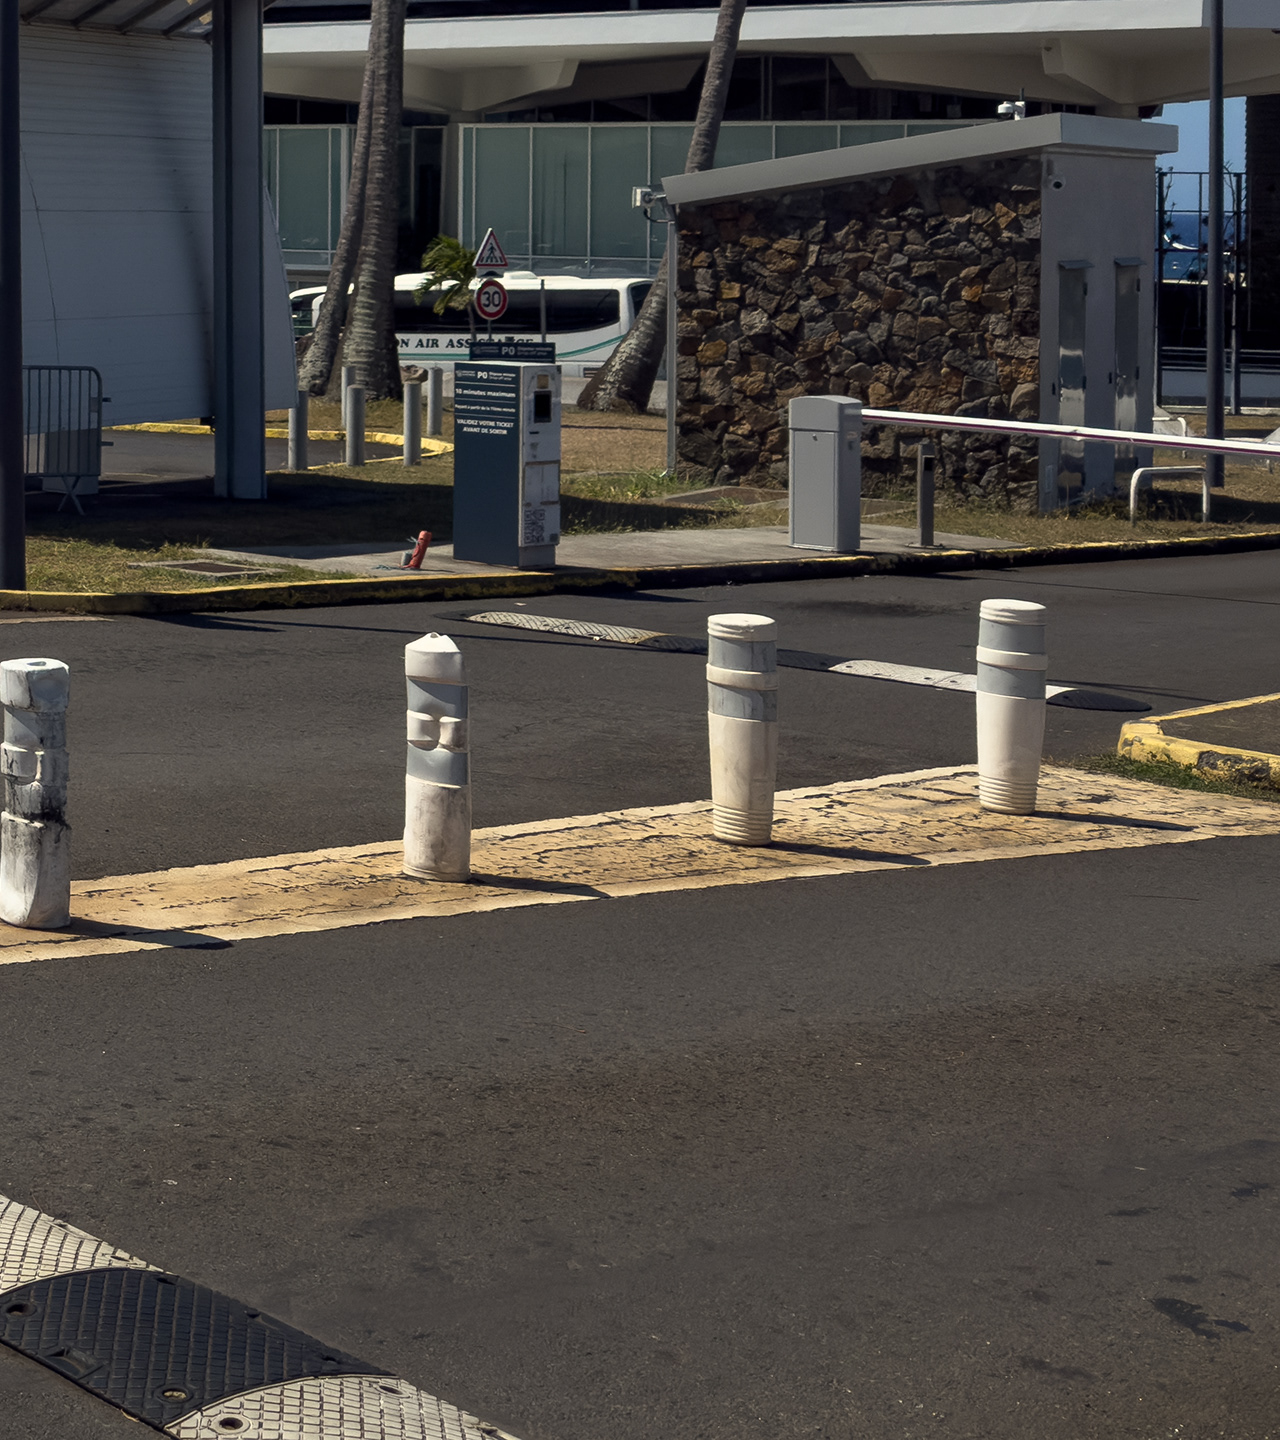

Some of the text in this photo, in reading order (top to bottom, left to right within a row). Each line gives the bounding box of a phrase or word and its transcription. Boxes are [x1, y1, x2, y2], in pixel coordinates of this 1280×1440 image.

[483, 291, 501, 308] 30
[415, 339, 439, 348] AIR
[477, 371, 488, 379] P0
